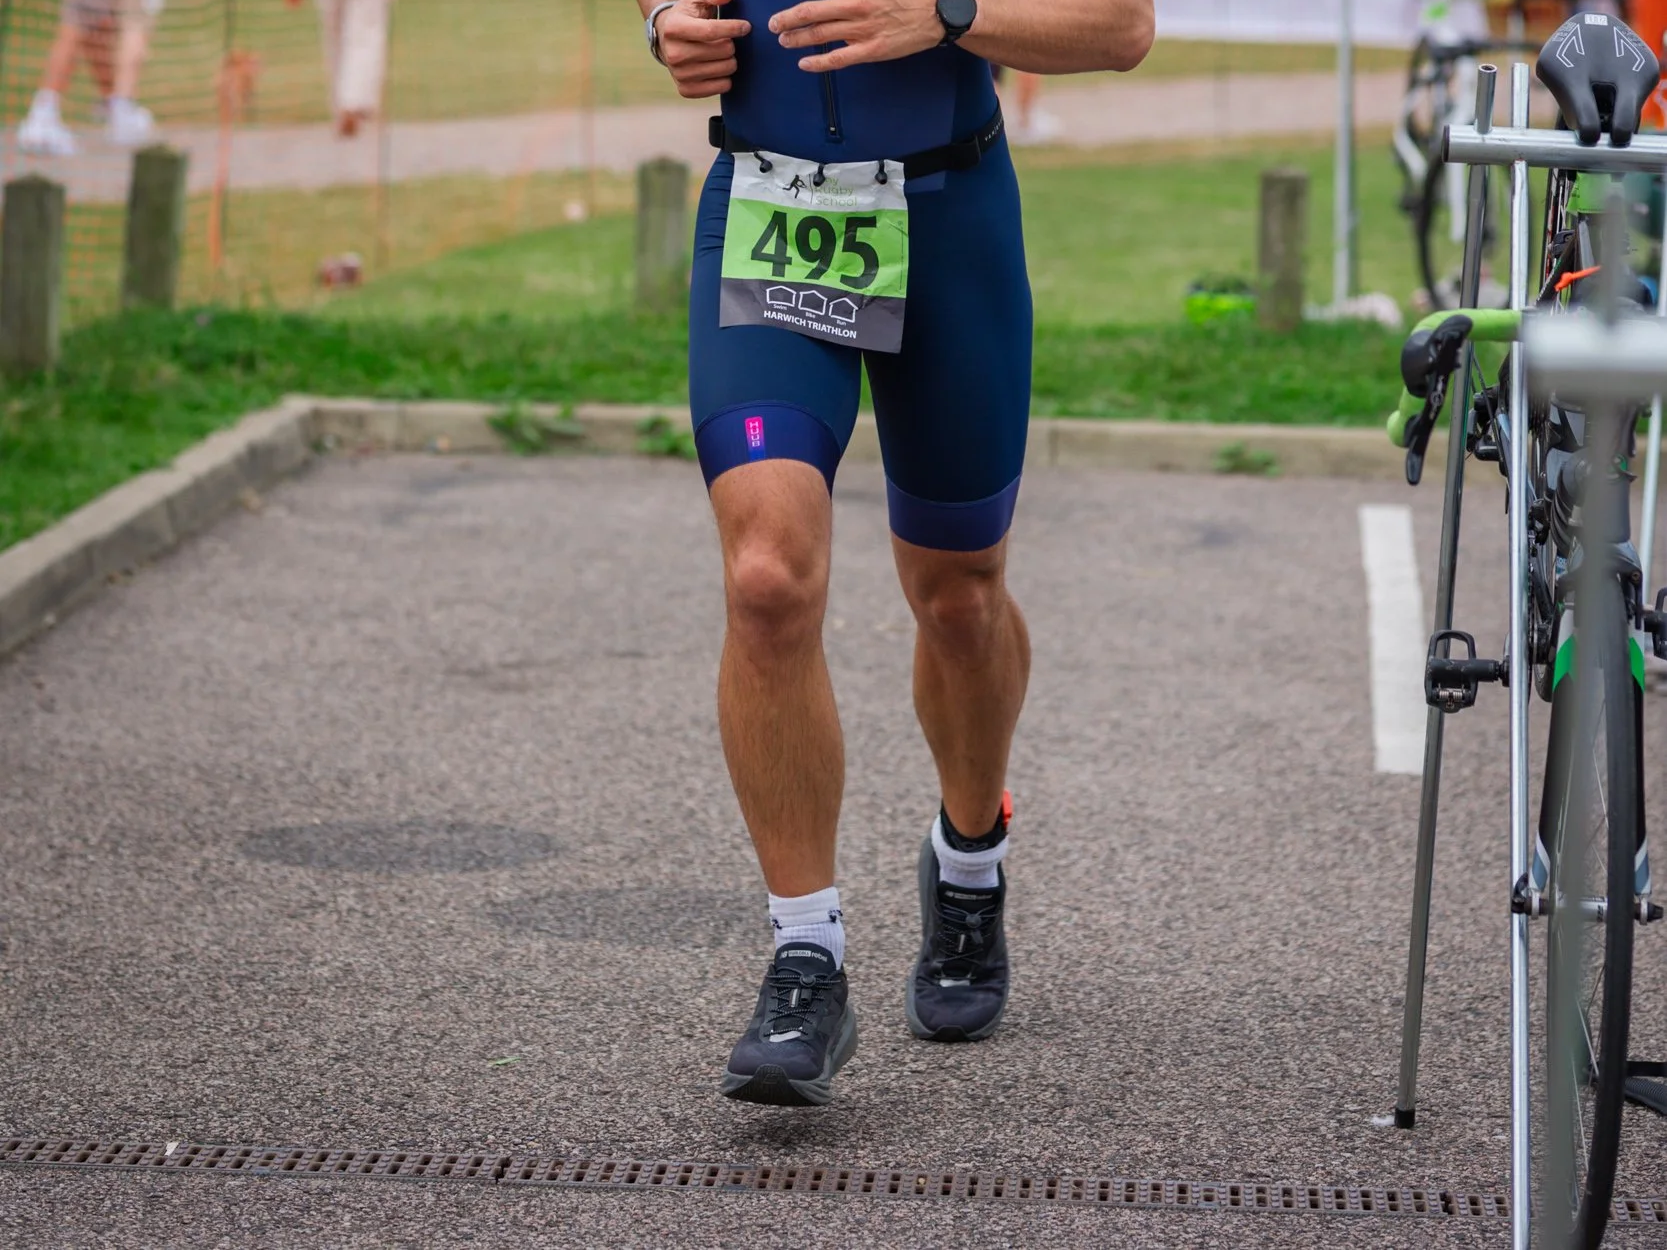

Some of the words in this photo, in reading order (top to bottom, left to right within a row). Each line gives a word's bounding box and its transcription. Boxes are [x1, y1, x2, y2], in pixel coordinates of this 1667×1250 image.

[815, 194, 857, 207] School
[750, 210, 880, 290] 495
[763, 310, 806, 327] HARWICH
[807, 320, 857, 339] TRIATHLON
